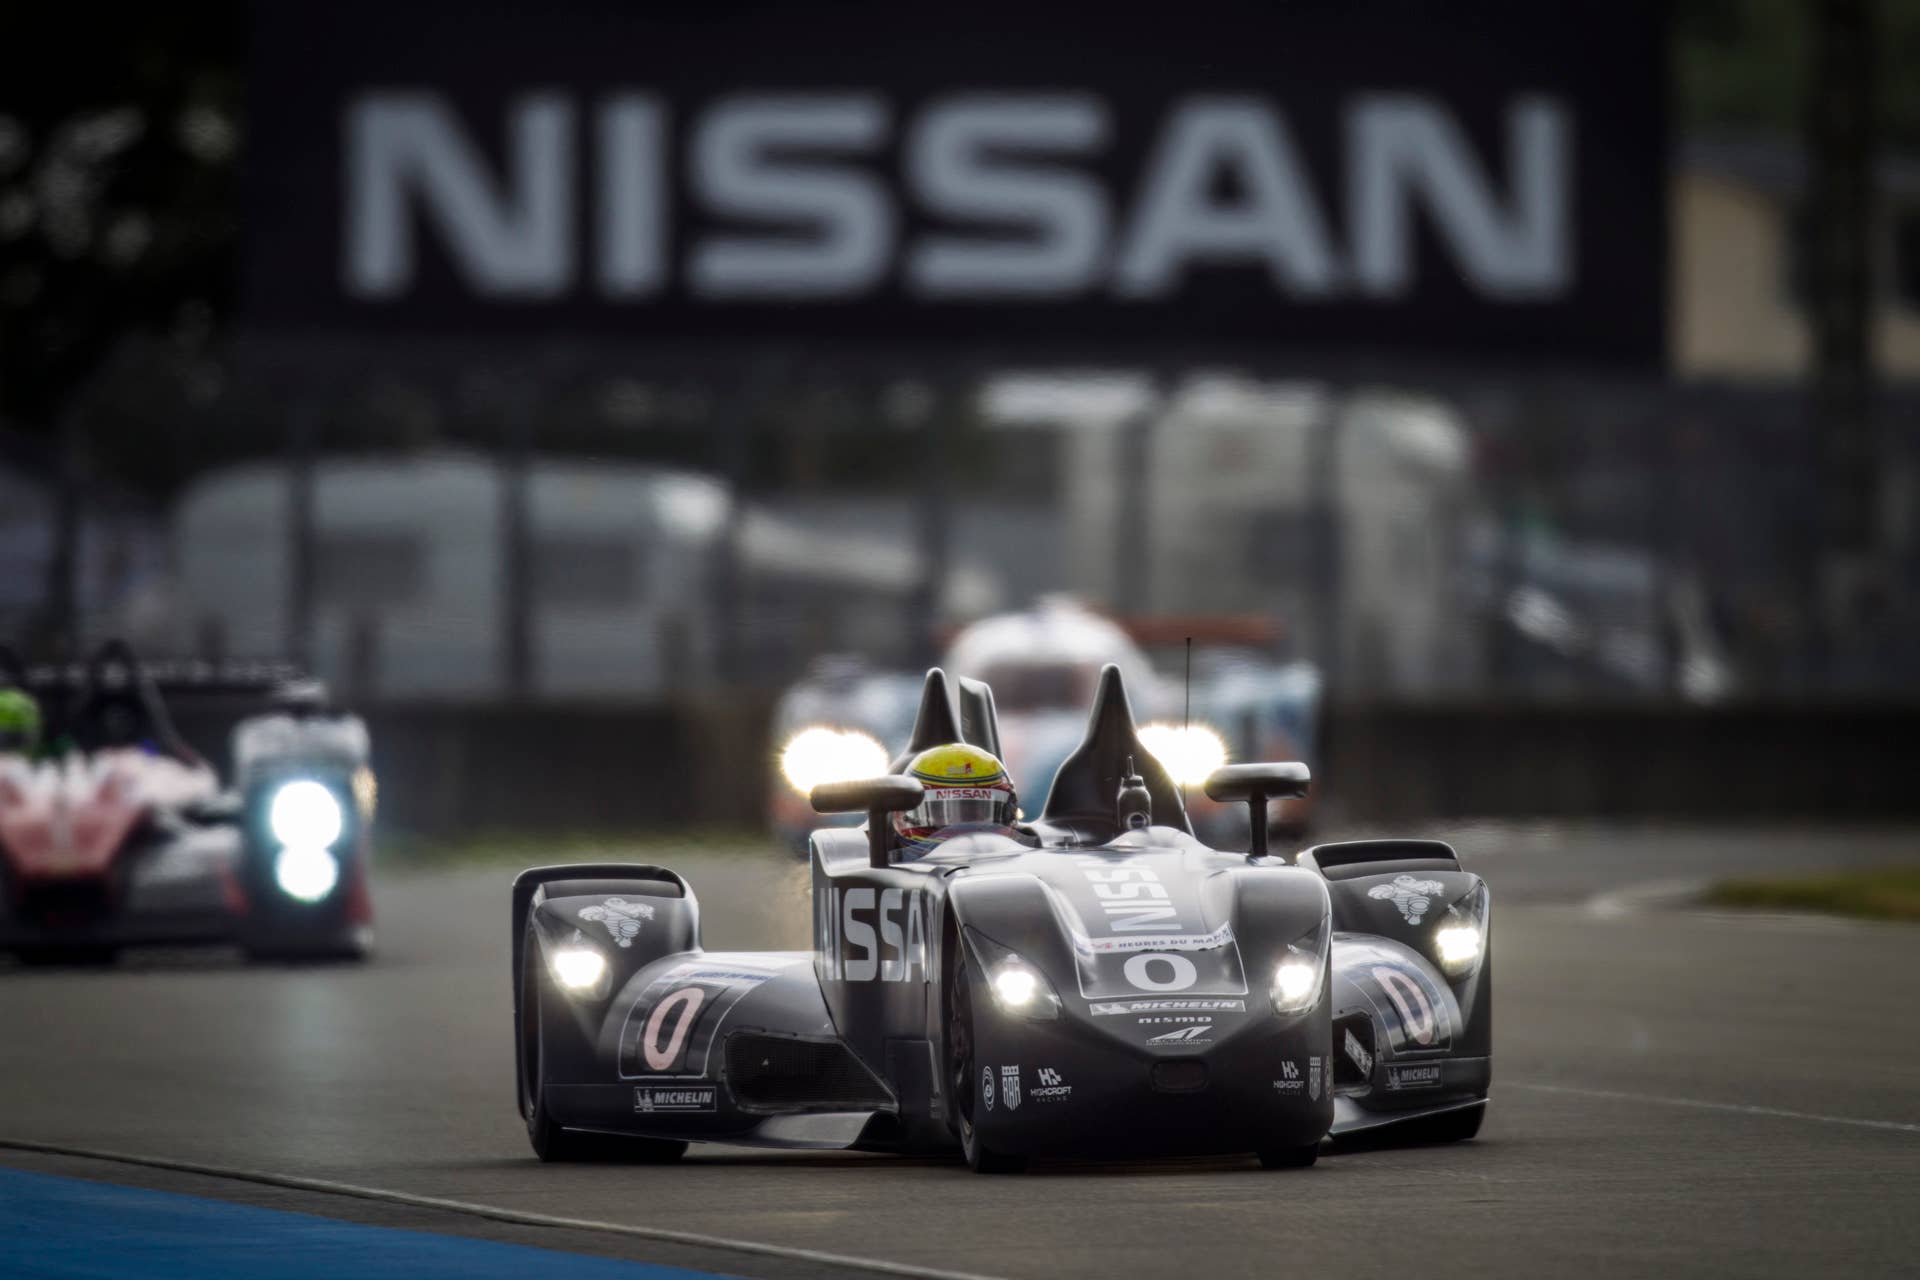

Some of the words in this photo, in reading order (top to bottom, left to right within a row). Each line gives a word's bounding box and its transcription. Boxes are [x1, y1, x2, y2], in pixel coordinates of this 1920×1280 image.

[347, 92, 1572, 300] NISSAN
[936, 790, 992, 800] NISSAN
[1079, 862, 1183, 932] NISS
[1130, 1000, 1238, 1010] MICHELIN
[643, 986, 705, 1071] 0
[654, 1091, 713, 1105] MICHELIN
[1030, 1085, 1073, 1097] HIGHCROFT
